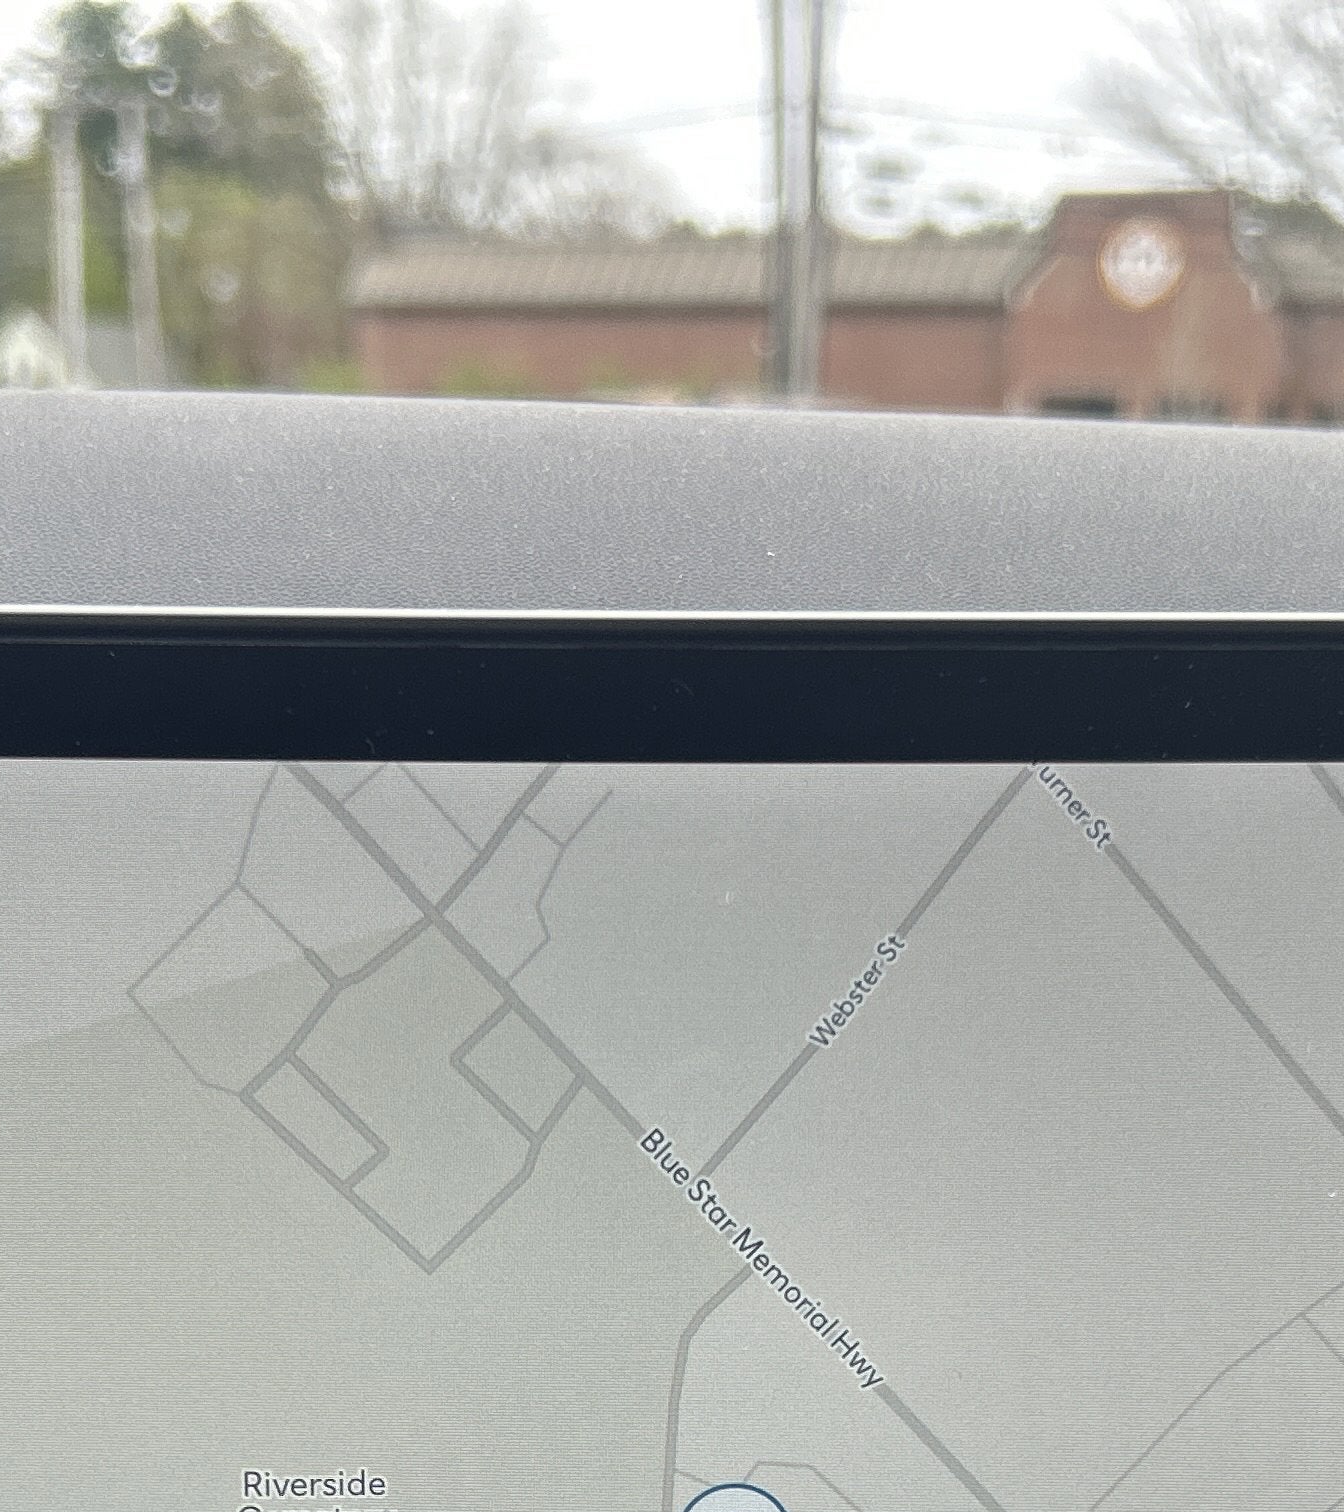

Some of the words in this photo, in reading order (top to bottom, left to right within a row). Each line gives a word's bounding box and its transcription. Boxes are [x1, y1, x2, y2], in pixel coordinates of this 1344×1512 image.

[1033, 762, 1091, 820] urner
[1086, 819, 1111, 849] St
[809, 960, 882, 1045] Webster
[877, 936, 905, 962] St
[640, 1128, 690, 1185] Blue
[688, 1179, 737, 1232] Star
[733, 1227, 839, 1337] Memorial
[831, 1329, 884, 1389] Hwy
[243, 1468, 386, 1497] Riverside
